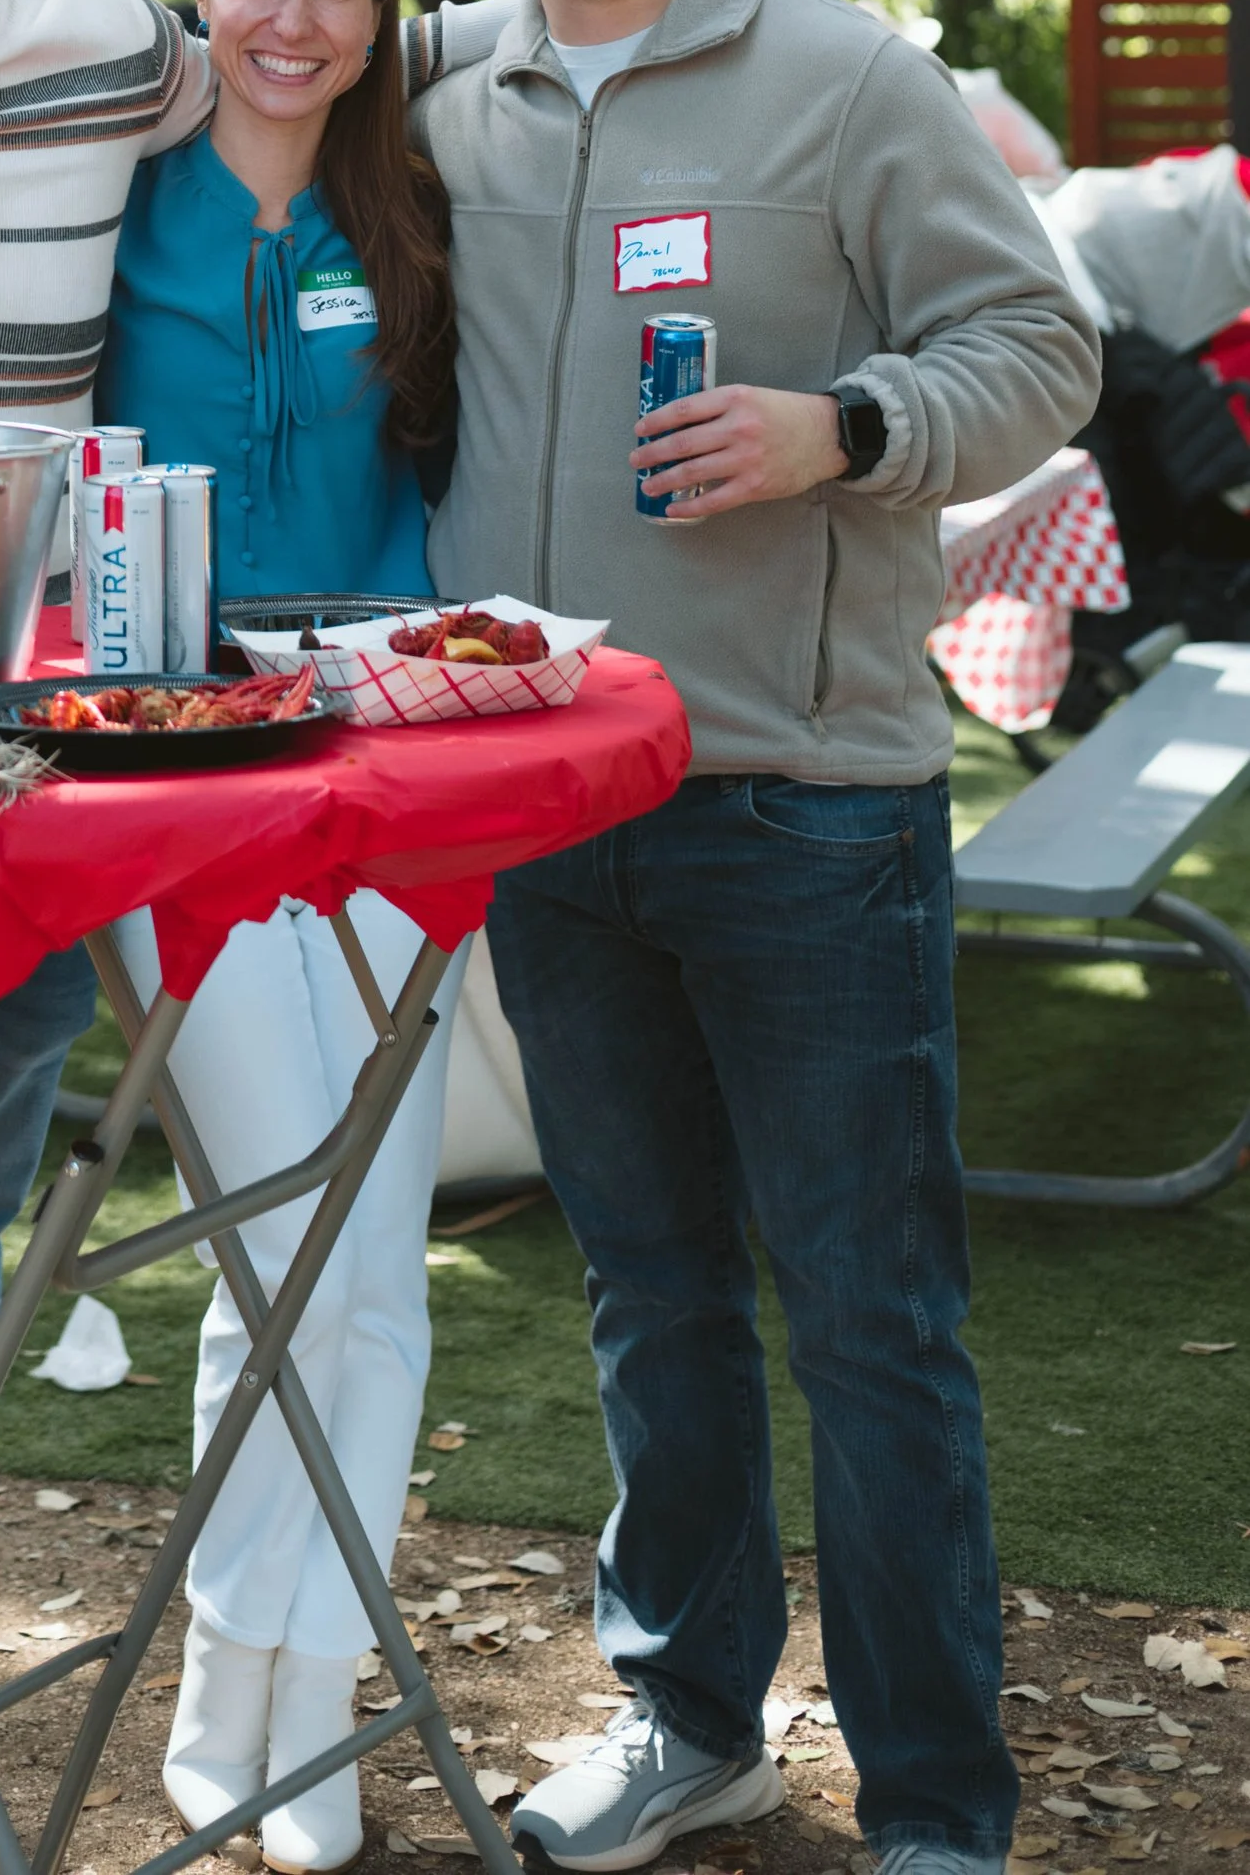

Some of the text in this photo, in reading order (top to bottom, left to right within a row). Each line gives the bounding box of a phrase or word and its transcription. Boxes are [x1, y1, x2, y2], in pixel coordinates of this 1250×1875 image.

[316, 271, 352, 283] HELLO
[308, 295, 362, 314] Jessica
[103, 544, 127, 668] ULTRA
